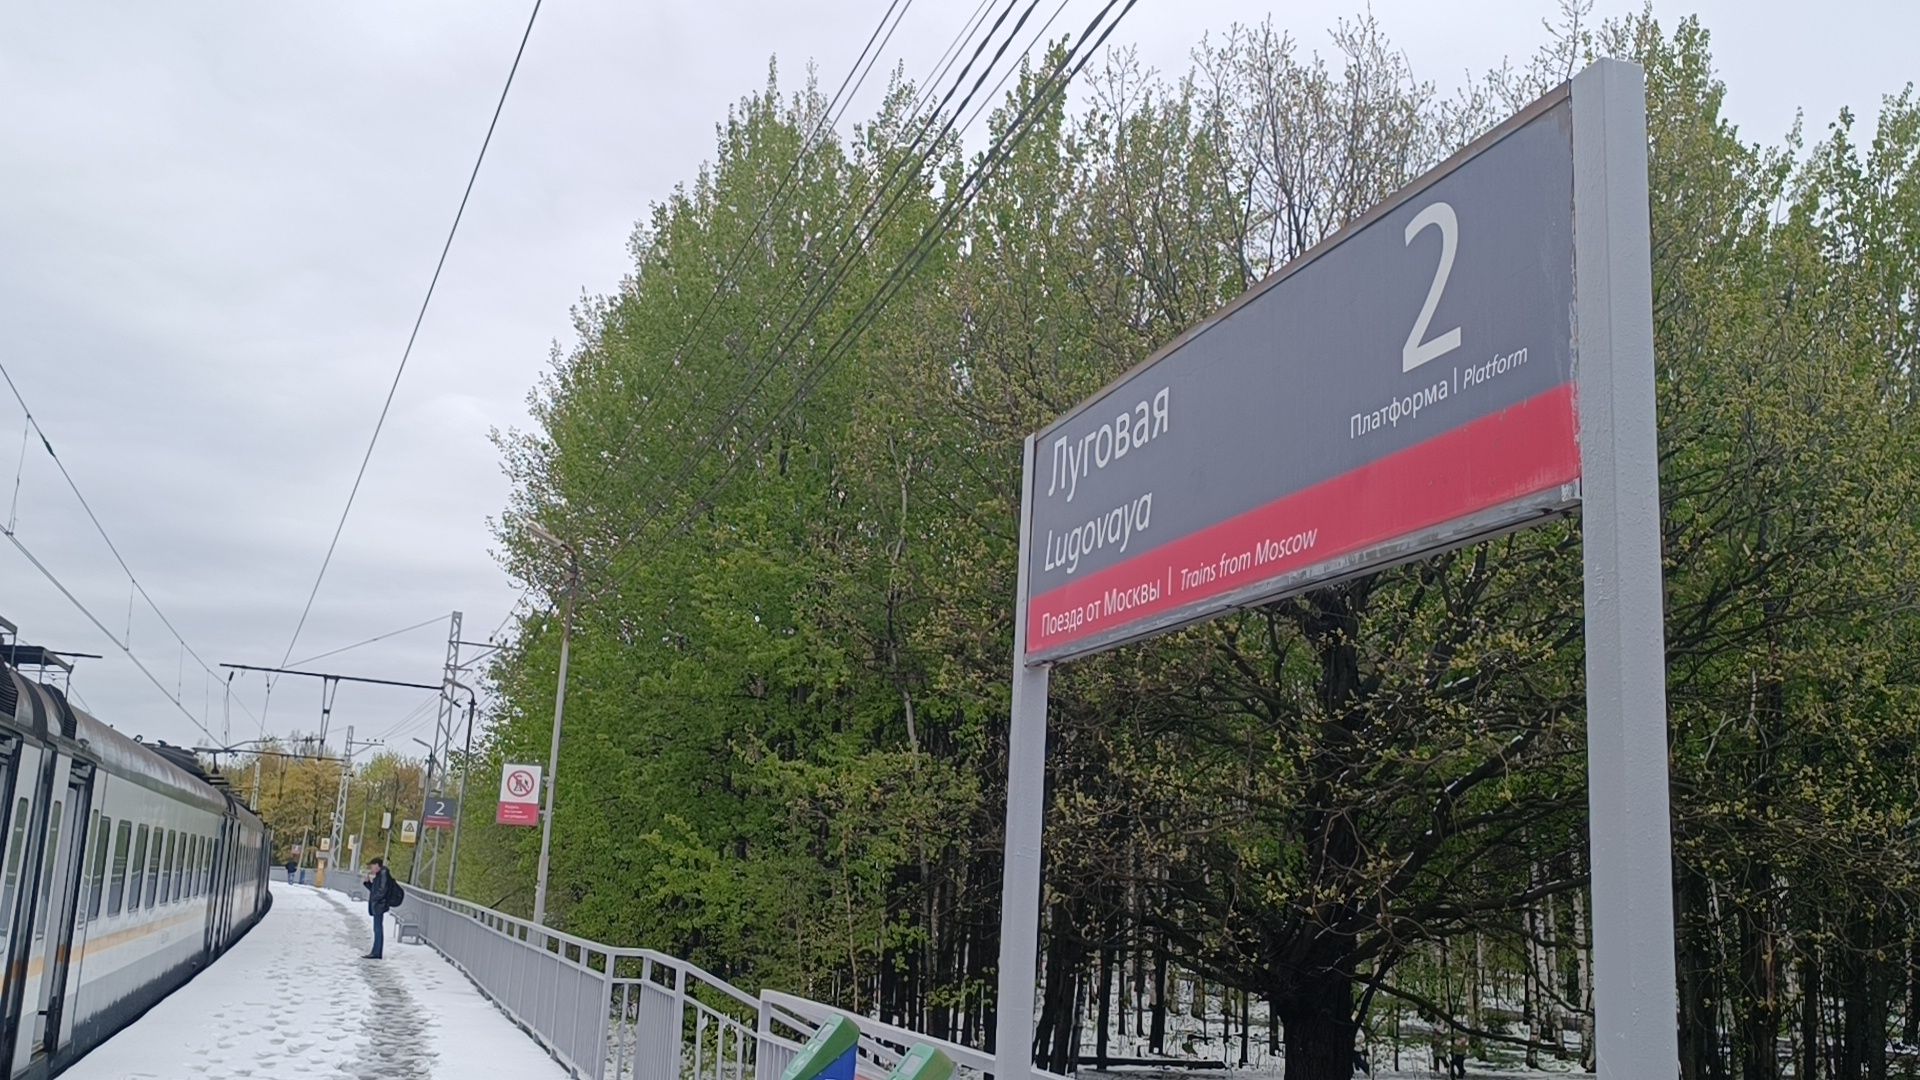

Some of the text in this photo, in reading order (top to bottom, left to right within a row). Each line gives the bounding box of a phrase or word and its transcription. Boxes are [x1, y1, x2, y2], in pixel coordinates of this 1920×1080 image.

[1402, 201, 1461, 374] 2
[1463, 347, 1528, 391] Platform
[1350, 380, 1448, 439] Платформа
[1048, 386, 1170, 502] Луговая
[1044, 492, 1152, 574] Lugovaya
[1180, 527, 1318, 592] Trains from Moscow
[1041, 580, 1160, 638] Поезда от Москвы
[434, 801, 445, 815] 2
